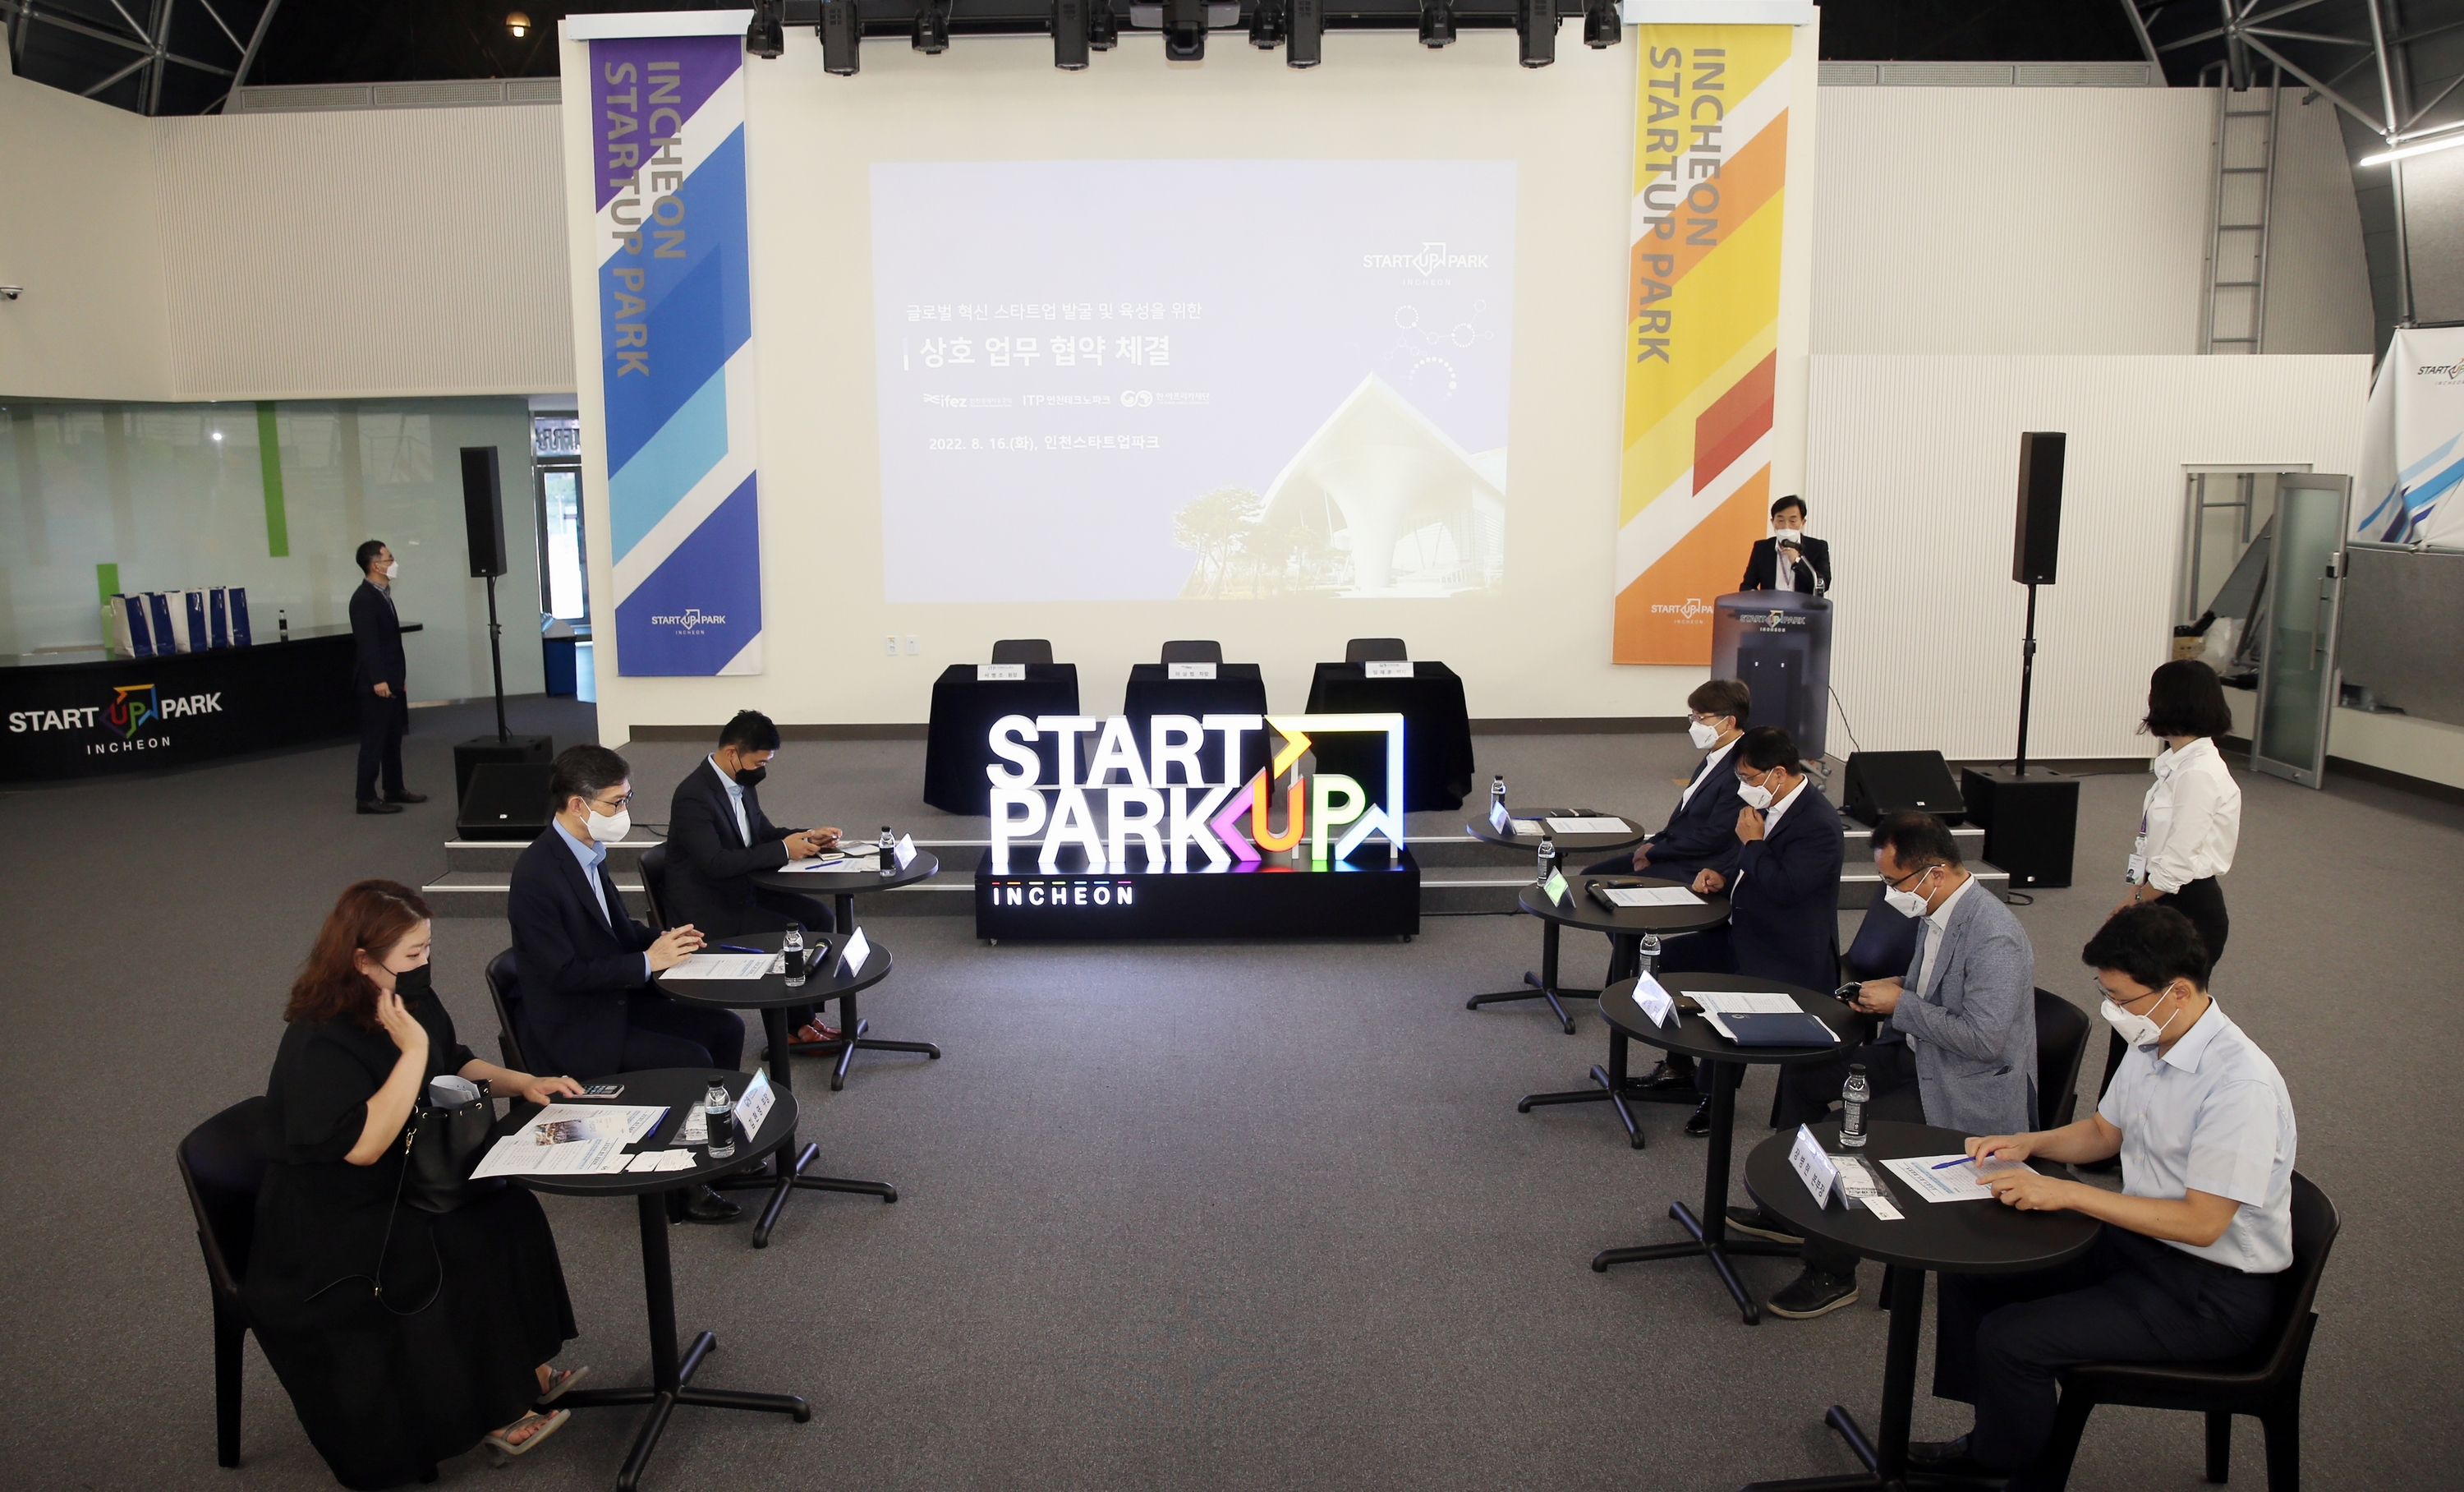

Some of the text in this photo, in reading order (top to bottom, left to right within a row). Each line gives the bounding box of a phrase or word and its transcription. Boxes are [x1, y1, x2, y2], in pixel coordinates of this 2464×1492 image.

[1685, 48, 1726, 247] INCHEON
[646, 61, 686, 260] INCHEON
[1637, 46, 1681, 365] STARTUP PARK
[604, 62, 650, 378] STARTUP PARK
[1363, 254, 1414, 268] START
[1448, 254, 1488, 268] PARK
[906, 302, 1202, 321] 글로벌 혁신 스타트업 발굴 및 육성을 위한
[919, 334, 1170, 368] 상호 업무 협약 체결
[2417, 366, 2451, 375] START
[940, 394, 967, 408] ifez
[1023, 394, 1111, 406] ITP 인천테크노파크
[929, 438, 967, 450] 2022.
[972, 438, 983, 450] 8.
[1044, 435, 1161, 449] 인천스타트업파크
[1651, 605, 1680, 614] START
[651, 615, 681, 624] START
[701, 615, 726, 624] PARK
[1740, 615, 1767, 623] START
[1783, 615, 1805, 624] PARK
[9, 707, 99, 733] START
[161, 692, 223, 720] PARK
[87, 736, 171, 755] INCHEON
[986, 714, 1264, 790] START
[990, 786, 1232, 863] PARK
[992, 885, 1133, 905] INCHEON
